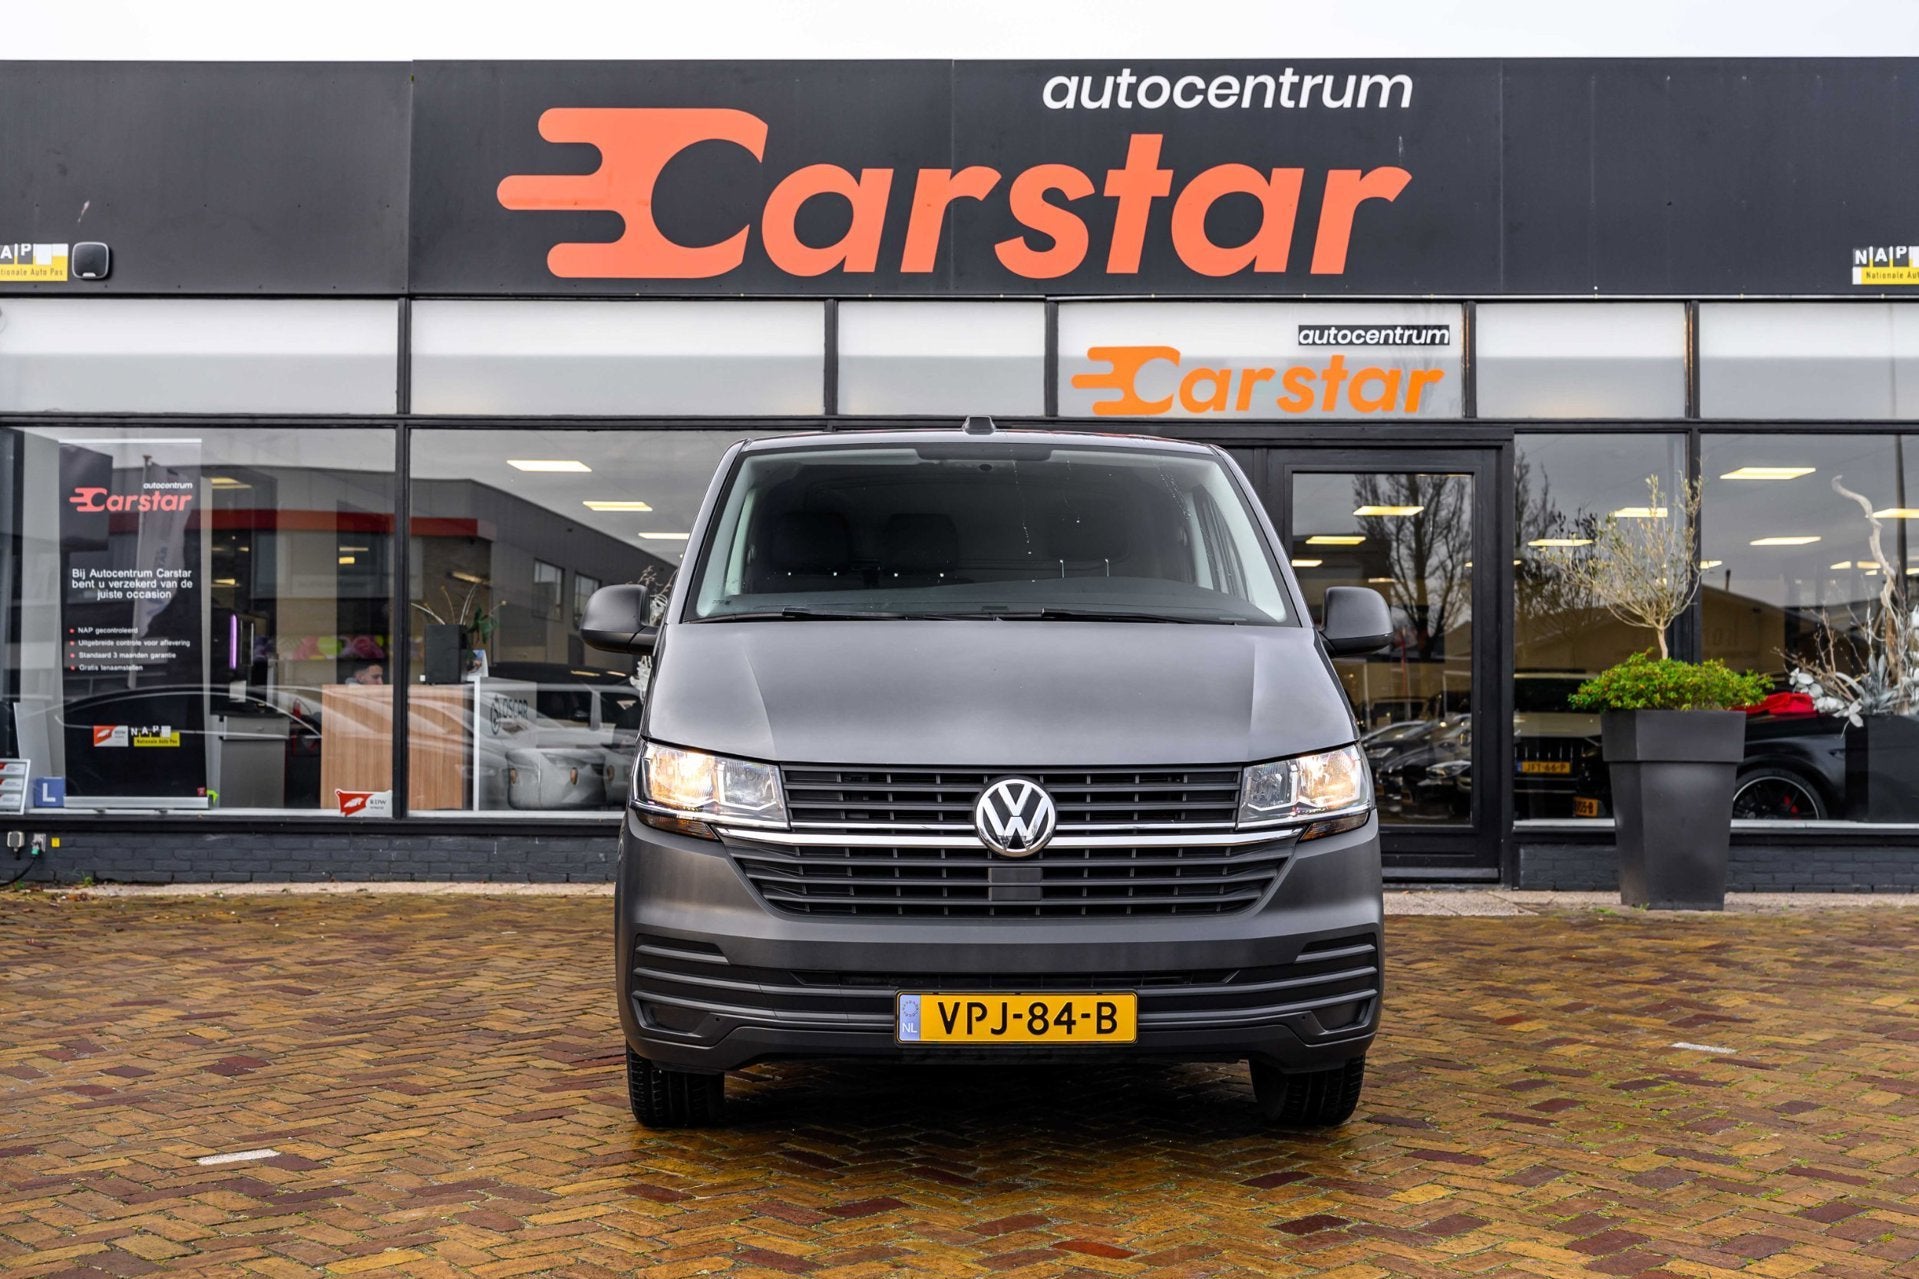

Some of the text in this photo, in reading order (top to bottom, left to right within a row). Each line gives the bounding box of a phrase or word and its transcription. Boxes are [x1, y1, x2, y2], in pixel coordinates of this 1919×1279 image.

[1042, 67, 1414, 111] autocentrum
[497, 107, 1413, 279] Carstar
[30, 268, 47, 276] Auto
[50, 268, 63, 276] Pas
[1866, 271, 1904, 279] Nationale
[1299, 325, 1450, 345] autocentrum
[1071, 345, 1445, 416] Carstar
[143, 482, 193, 490] autocentrum
[69, 487, 193, 512] Carstar
[72, 568, 192, 580] Bij Autocentrum Carstar
[72, 579, 95, 588] bent
[108, 579, 157, 588] verzekerd
[181, 579, 193, 588] de
[97, 590, 172, 601] juiste occasion
[42, 782, 57, 803] L
[937, 1001, 1119, 1036] VPJ-84-B
[901, 1022, 918, 1034] NL
